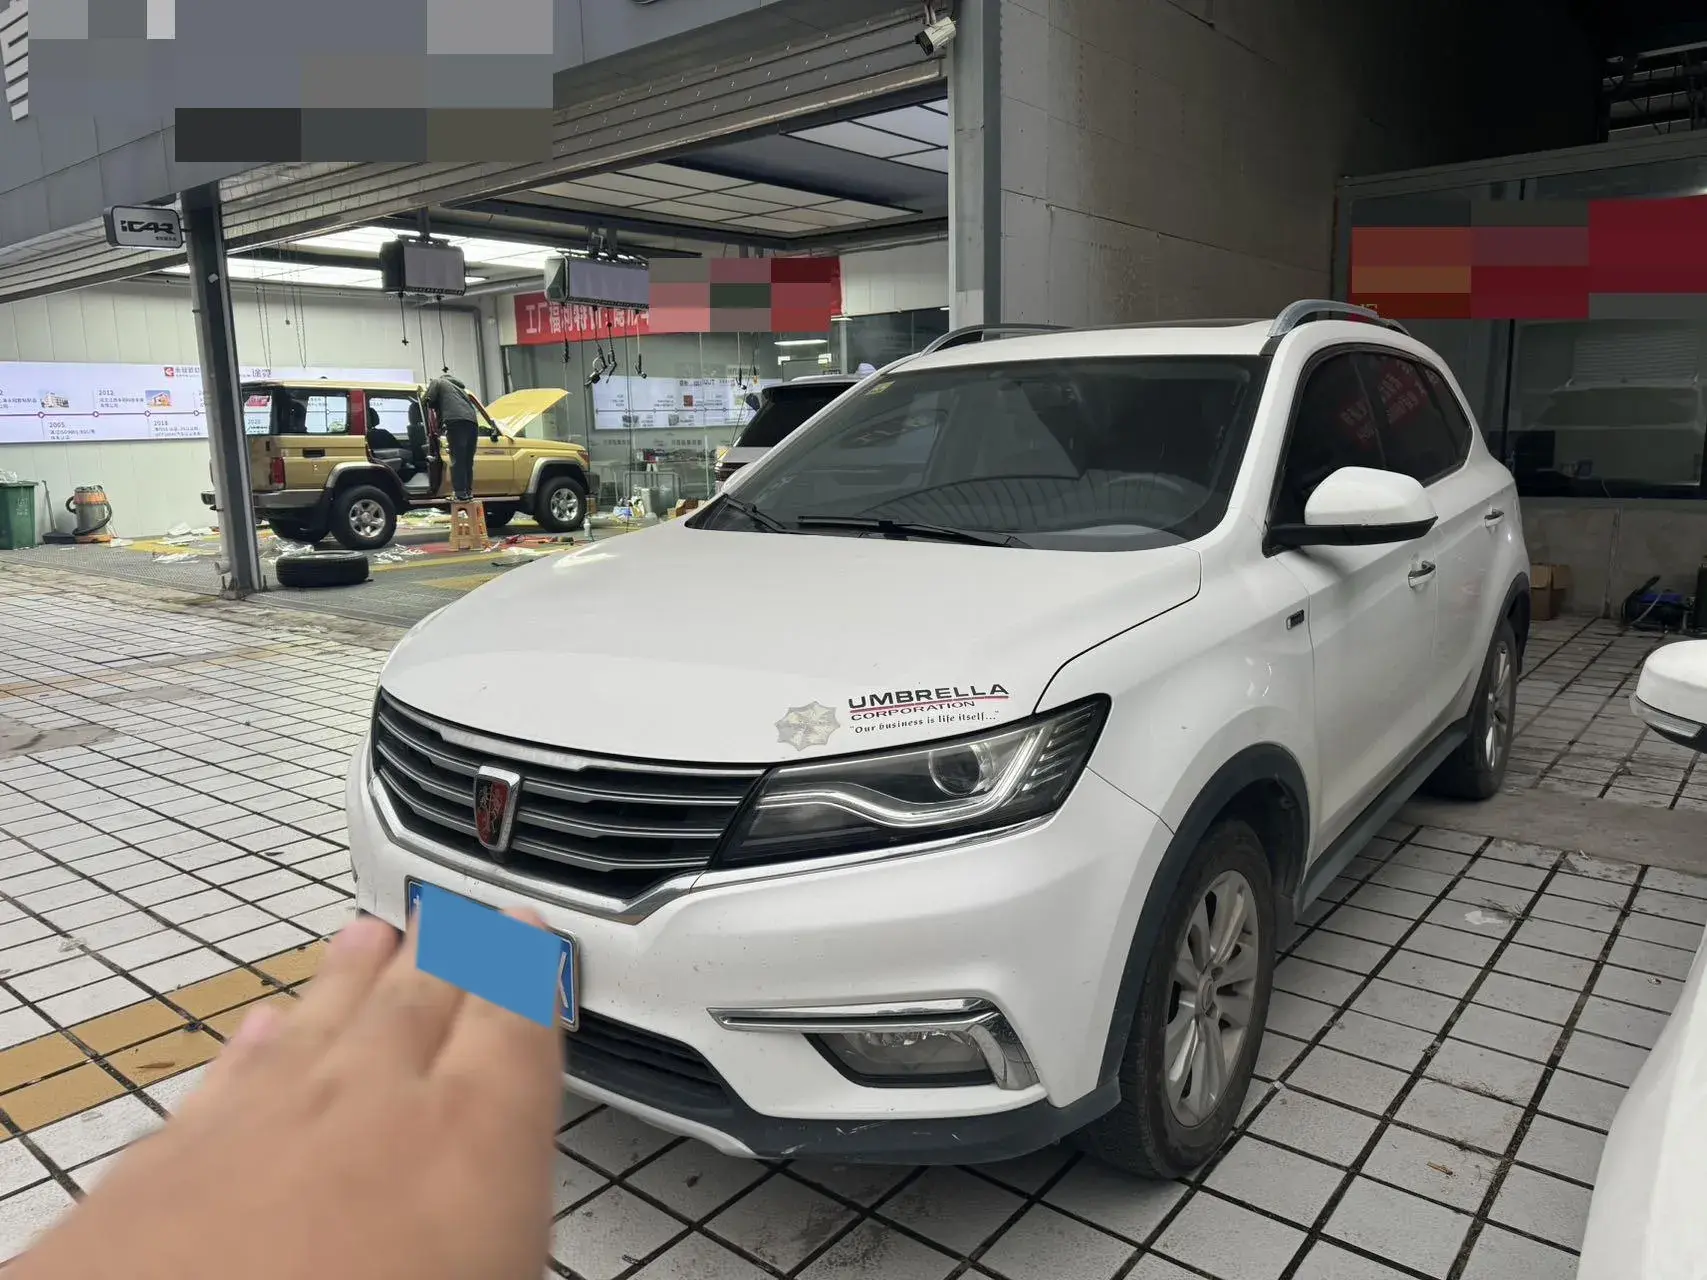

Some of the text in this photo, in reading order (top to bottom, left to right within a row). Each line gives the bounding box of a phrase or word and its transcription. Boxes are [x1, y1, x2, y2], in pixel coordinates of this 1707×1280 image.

[849, 684, 1009, 709] UMBRELLA
[851, 701, 975, 721] CORPORATION
[879, 720, 924, 731] business
[938, 715, 955, 723] life
